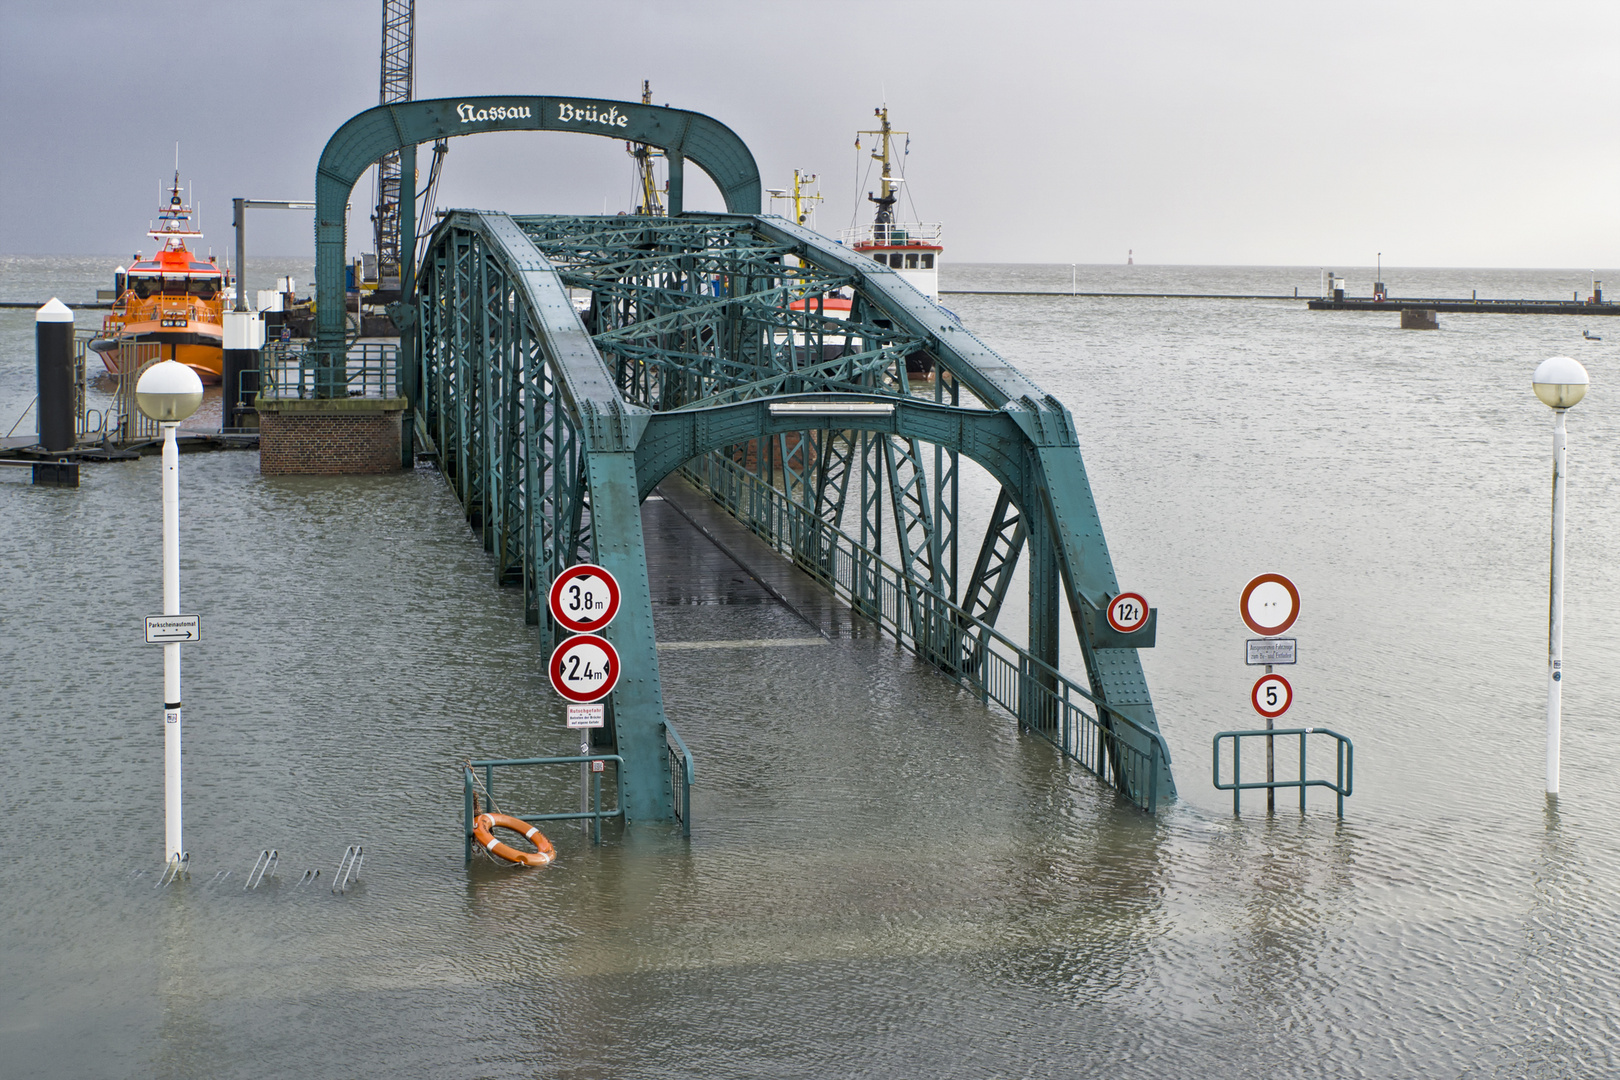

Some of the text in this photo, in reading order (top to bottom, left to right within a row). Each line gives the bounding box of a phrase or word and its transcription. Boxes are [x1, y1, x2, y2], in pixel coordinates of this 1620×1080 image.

[456, 102, 629, 128] Nassau Brücke
[1118, 603, 1139, 621] 12t
[1266, 686, 1278, 706] 5
